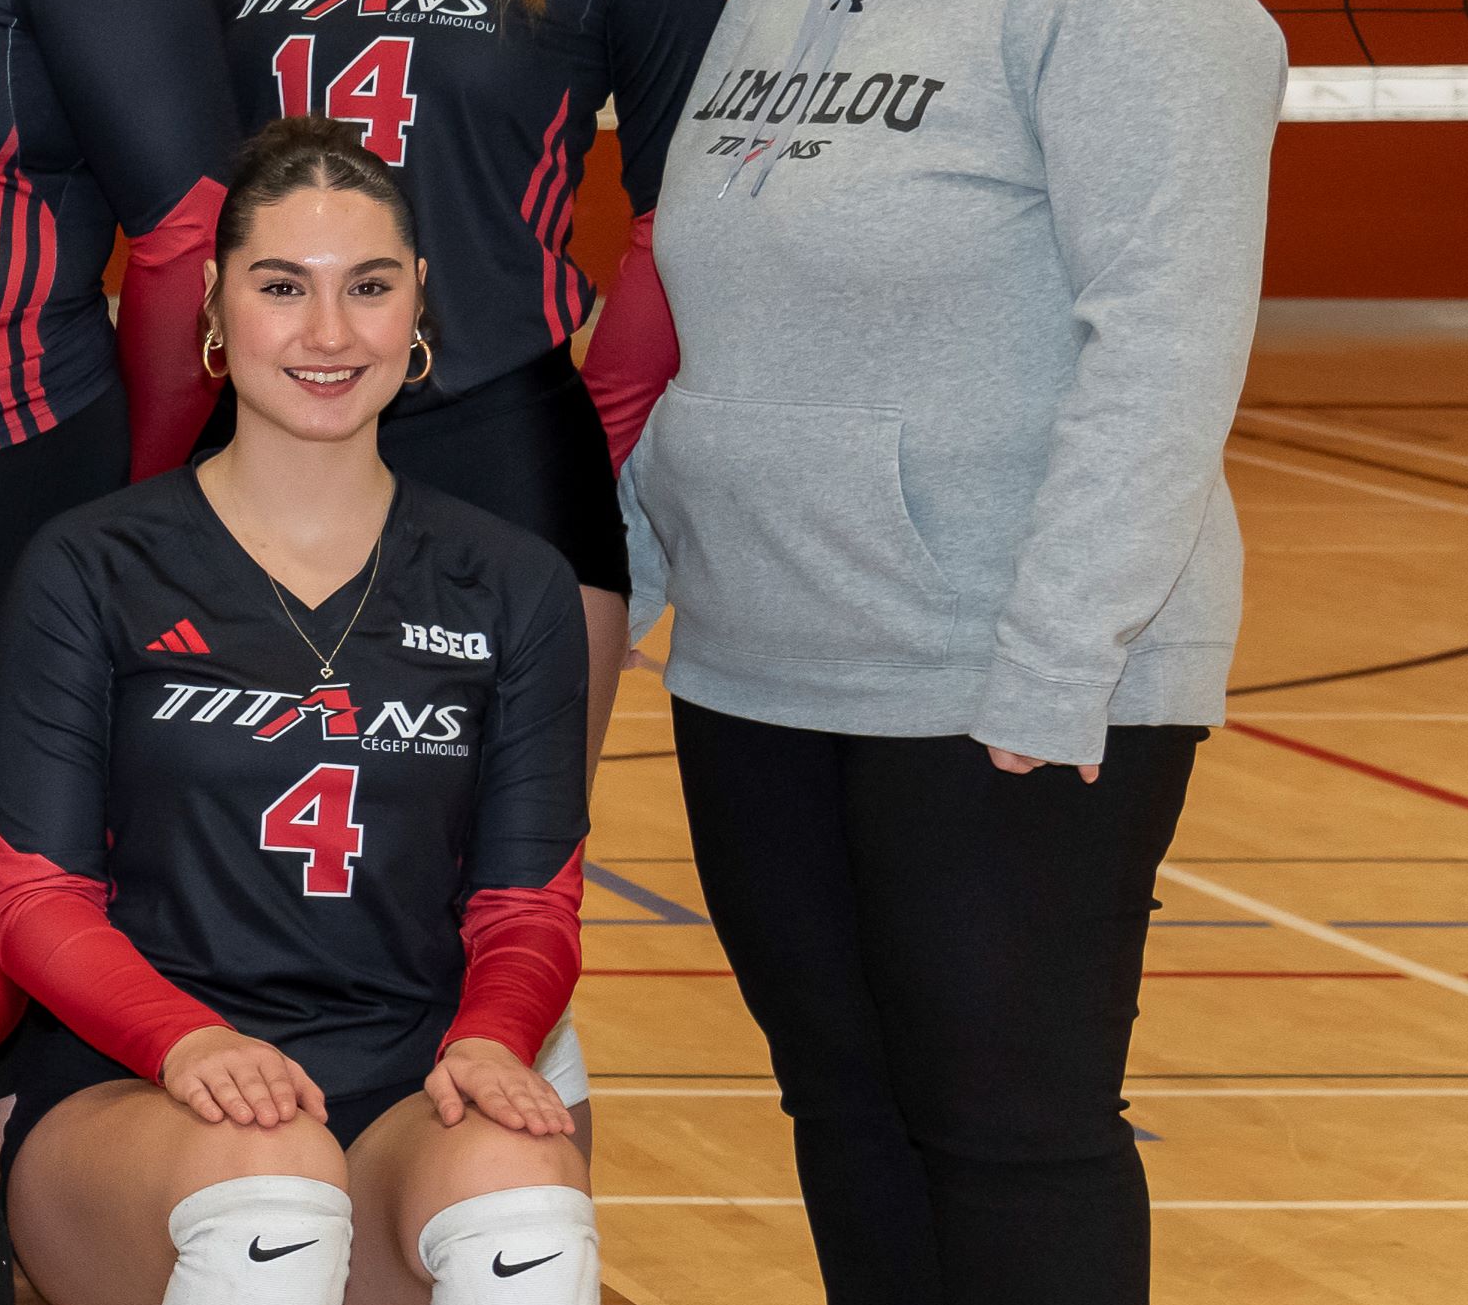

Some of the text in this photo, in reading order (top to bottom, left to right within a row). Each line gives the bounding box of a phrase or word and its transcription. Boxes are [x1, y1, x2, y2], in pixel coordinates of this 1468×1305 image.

[385, 10, 496, 34] CÉGEP LIMOILOU
[271, 34, 418, 168] 14
[692, 68, 946, 134] LIMOILOU
[400, 621, 493, 661] RSEQ
[151, 682, 469, 742] TITANS
[360, 733, 470, 758] CÉGEP LIMOILOU
[259, 762, 364, 898] 4
